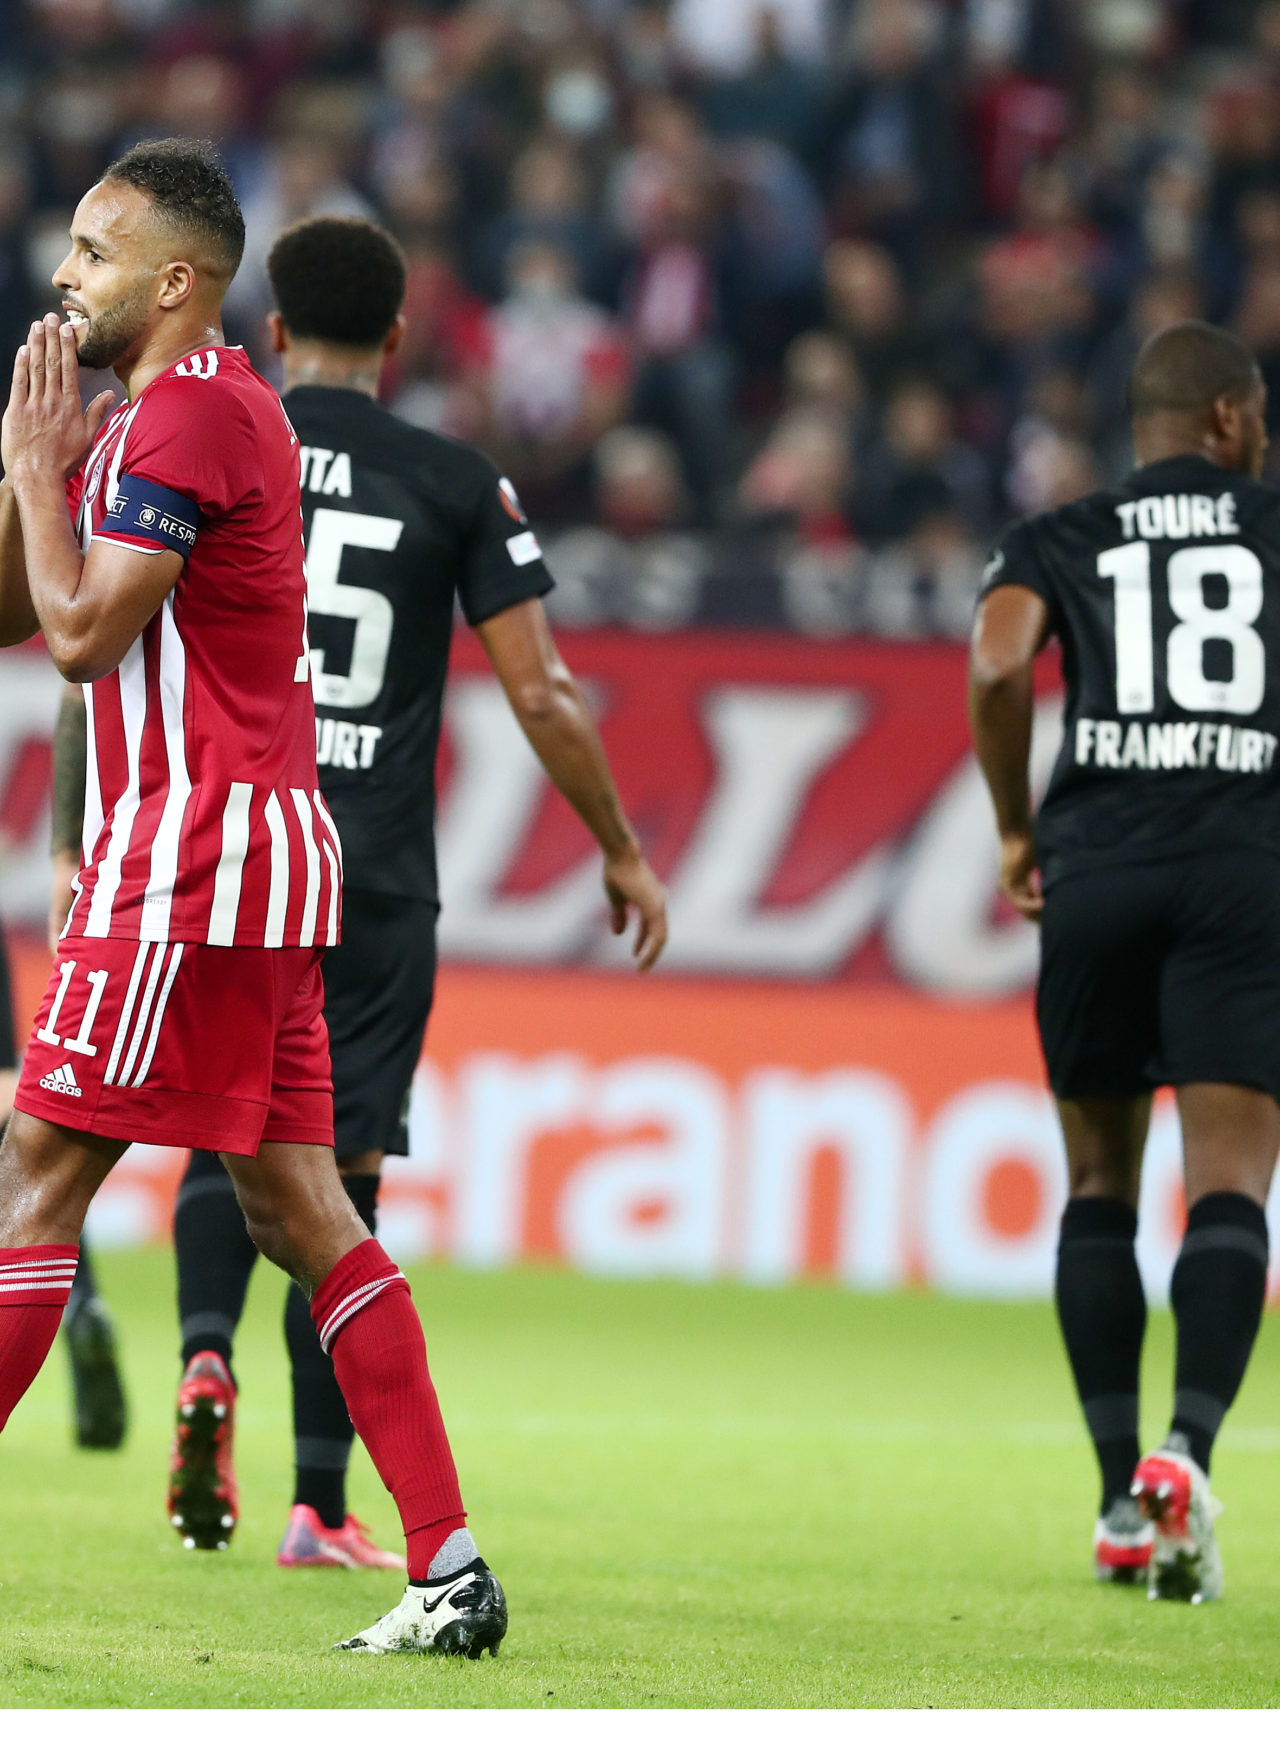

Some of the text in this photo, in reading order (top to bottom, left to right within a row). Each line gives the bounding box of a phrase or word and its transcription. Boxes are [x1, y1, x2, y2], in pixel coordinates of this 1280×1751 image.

[1115, 492, 1240, 539] TOURÉ
[1096, 540, 1266, 715] 18
[1075, 718, 1278, 773] FRANKFURT
[36, 960, 109, 1057] 11
[39, 1078, 82, 1098] adidas
